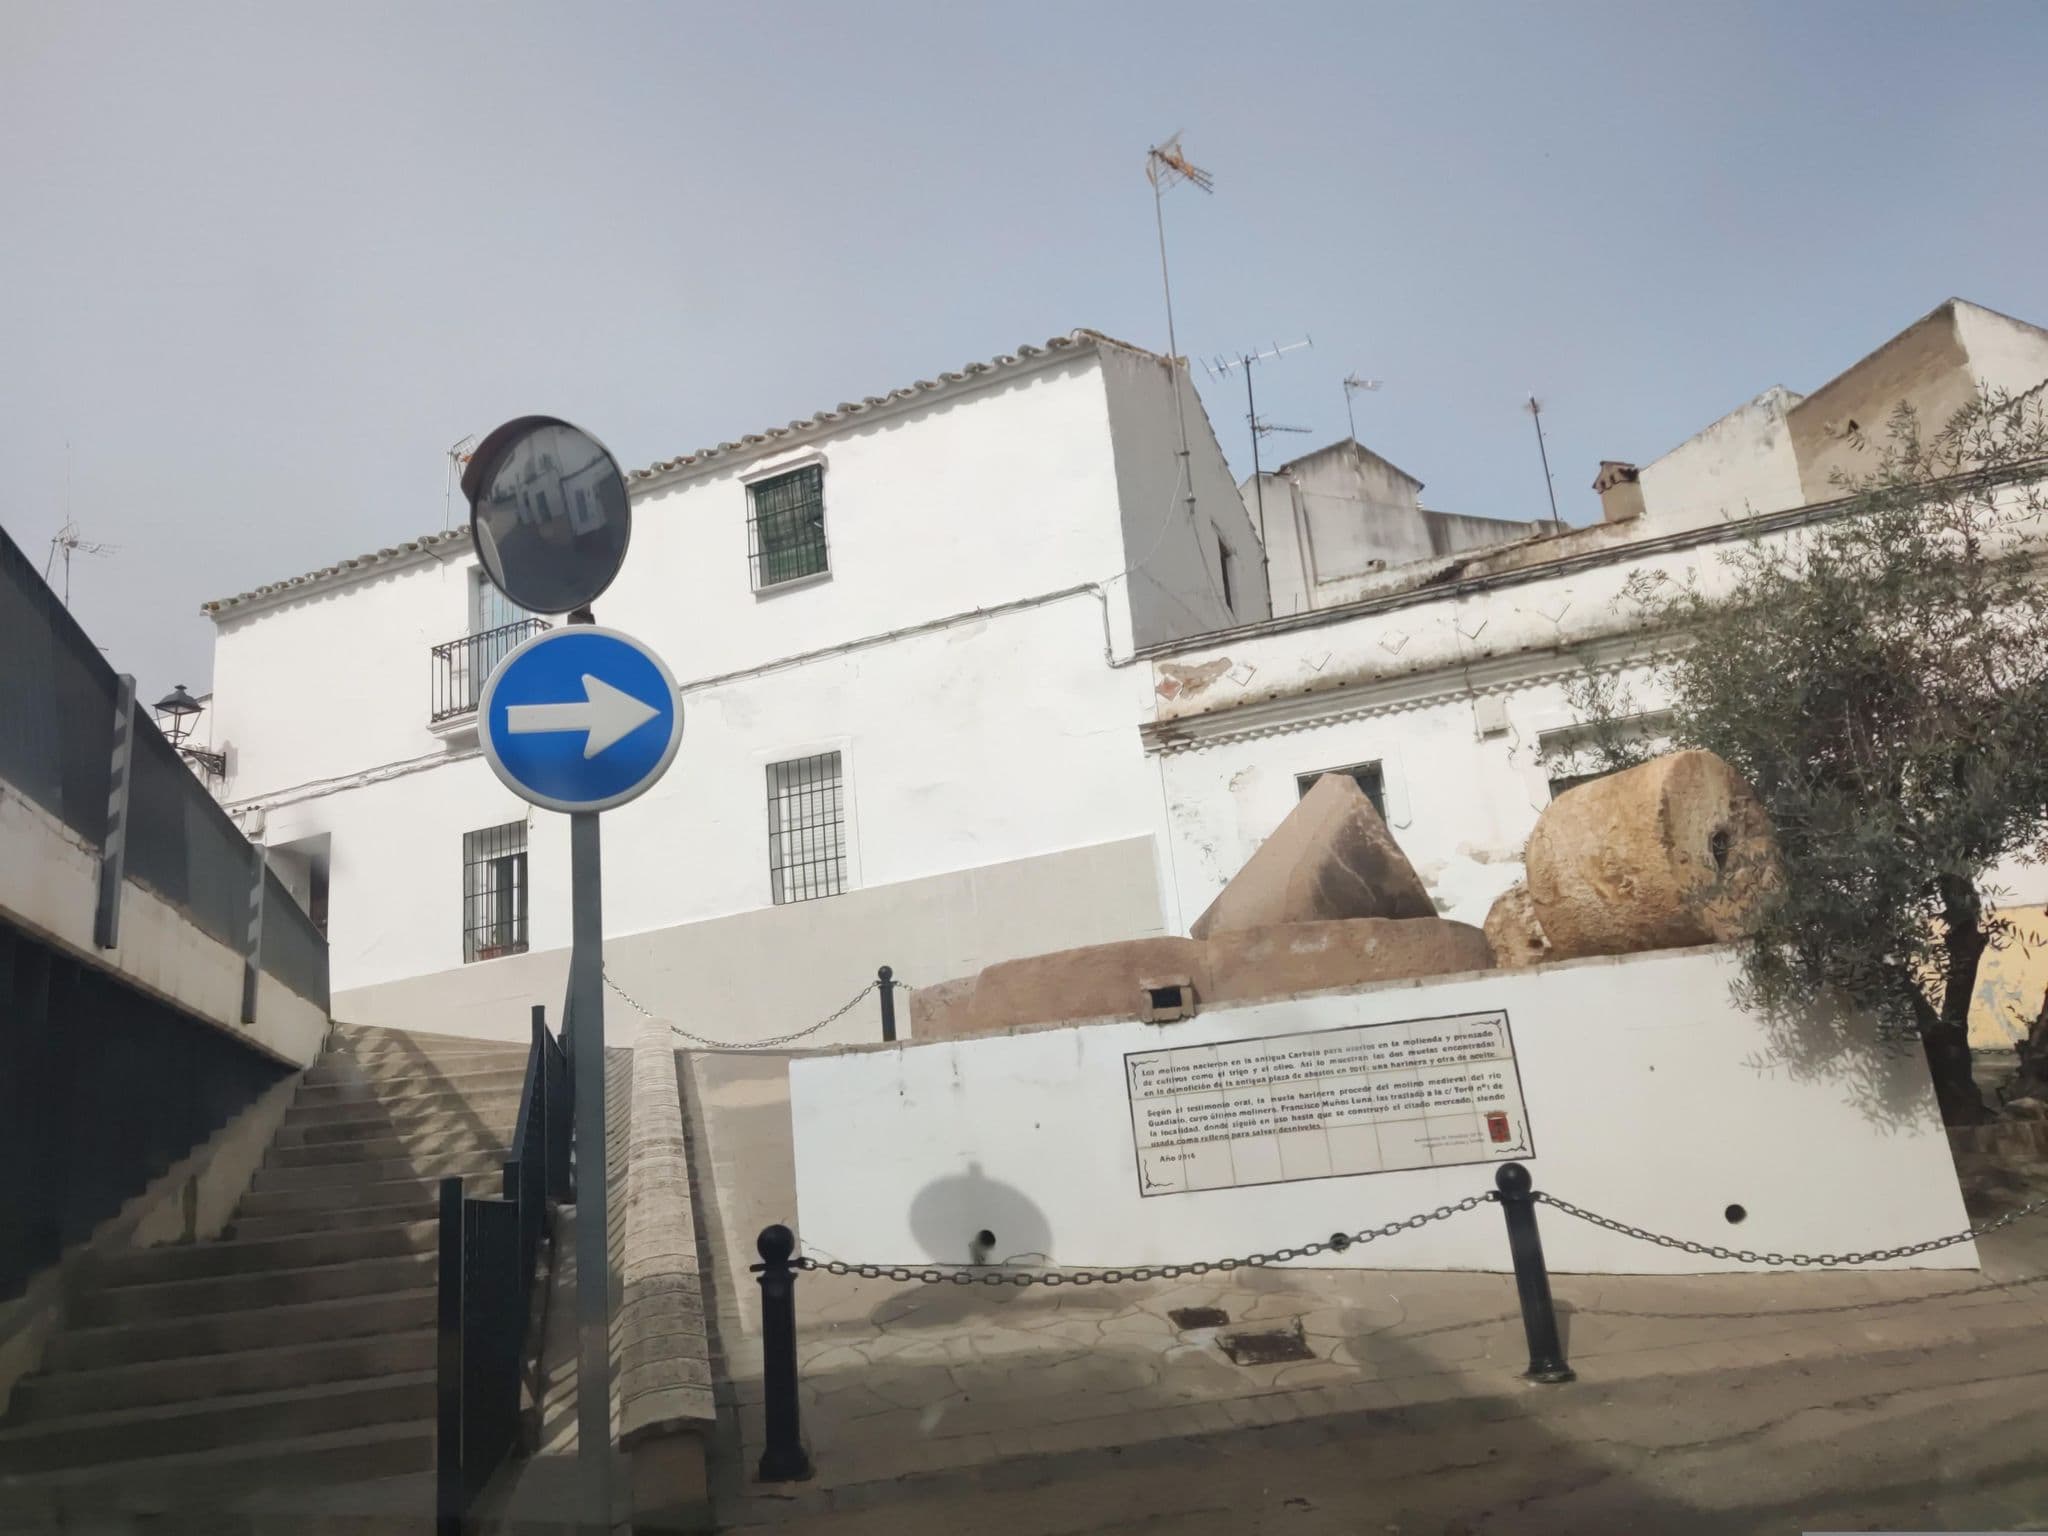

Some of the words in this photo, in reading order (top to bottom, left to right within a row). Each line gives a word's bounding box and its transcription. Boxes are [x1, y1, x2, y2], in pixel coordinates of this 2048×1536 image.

[1155, 1076, 1187, 1084] cultivos
[1228, 1068, 1248, 1076] trigo
[1328, 1055, 1368, 1064] muestran
[1407, 1047, 1438, 1055] muelas
[1441, 1040, 1495, 1052] encontradas
[1157, 1065, 1190, 1074] molinos
[1192, 1060, 1228, 1070] nacieron
[1254, 1054, 1285, 1062] antigua
[1323, 1047, 1342, 1056] para
[1402, 1035, 1442, 1045] molienda
[1235, 1076, 1266, 1085] antigua
[1268, 1074, 1289, 1083] plaza
[1303, 1068, 1334, 1077] abastos
[1390, 1059, 1426, 1068] harinera
[1436, 1055, 1454, 1063] otra
[1186, 1101, 1230, 1112] testimonio
[1270, 1093, 1294, 1102] muela
[1298, 1090, 1335, 1099] harinera
[1338, 1085, 1372, 1096] procede
[1375, 1083, 1389, 1091] del
[1393, 1080, 1424, 1089] molino
[1427, 1074, 1467, 1085] medieval
[1469, 1072, 1484, 1080] del
[1280, 1102, 1320, 1111] Francisco
[1202, 1122, 1228, 1130] donde
[1290, 1112, 1314, 1121] hasta
[1316, 1111, 1332, 1120] que
[1403, 1100, 1430, 1109] citado
[1476, 1092, 1505, 1101] siendo
[1150, 1139, 1174, 1147] usada
[1200, 1133, 1229, 1142] relleno
[1231, 1131, 1249, 1140] para
[1251, 1128, 1276, 1136] salvar
[1159, 1154, 1175, 1162] Año
